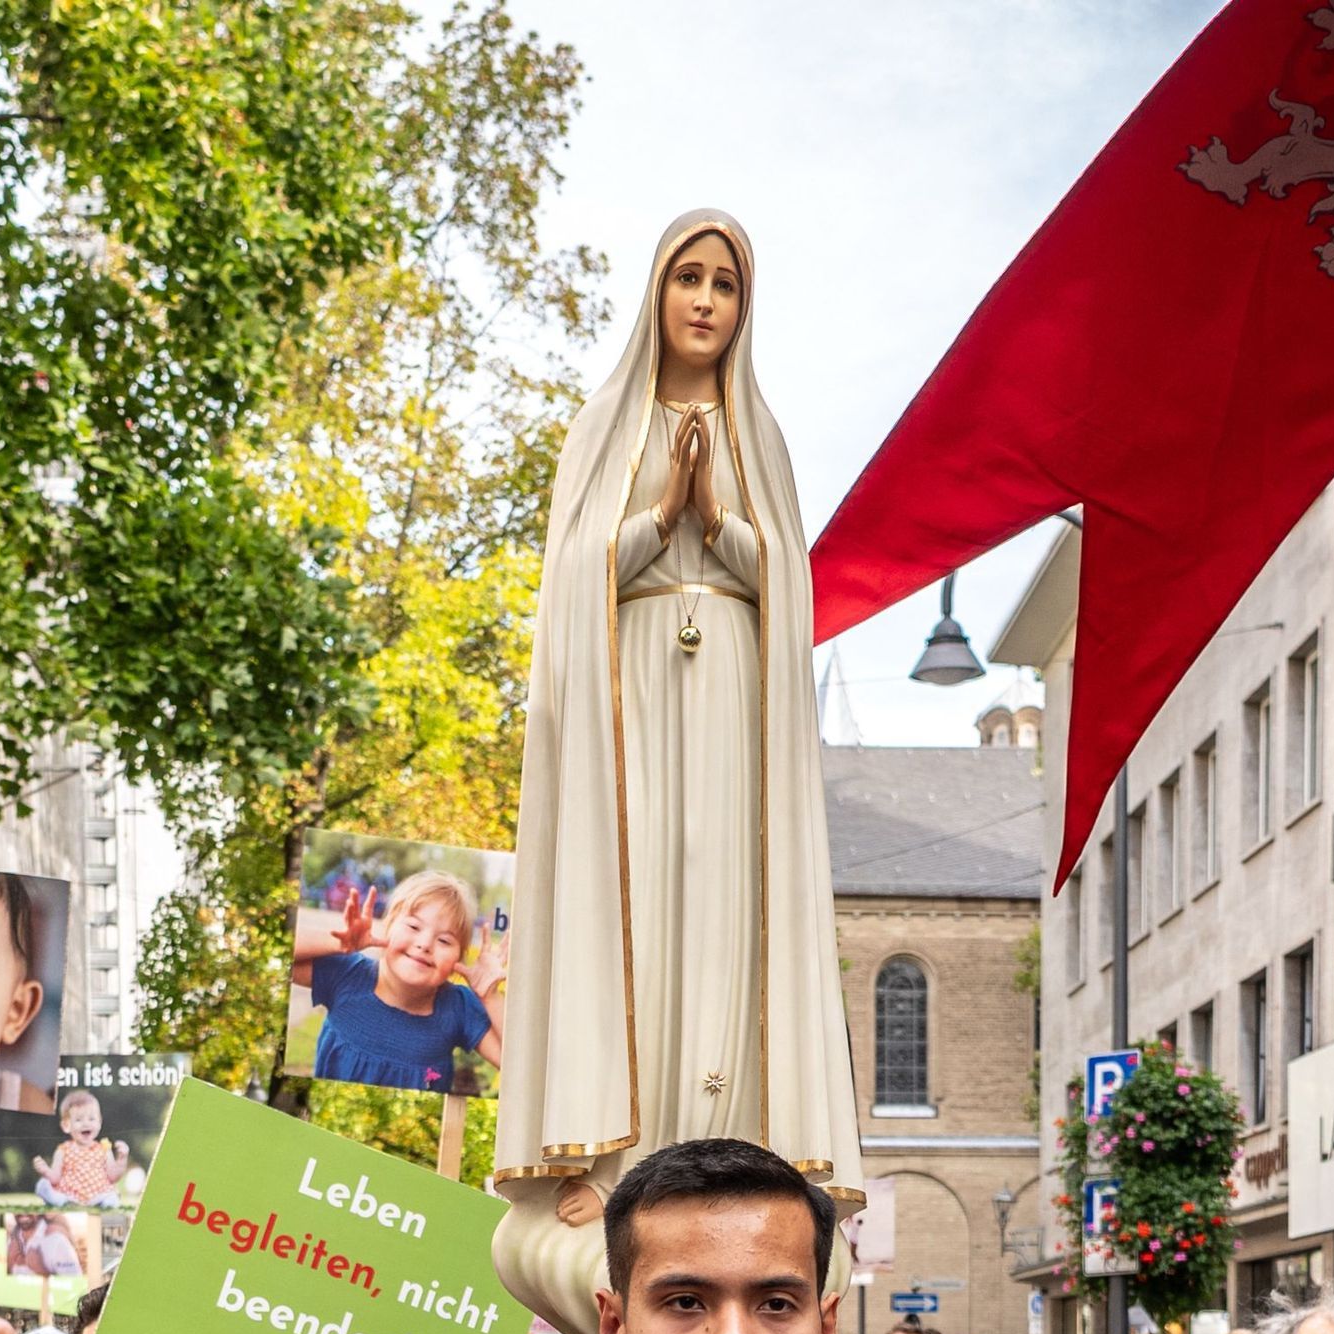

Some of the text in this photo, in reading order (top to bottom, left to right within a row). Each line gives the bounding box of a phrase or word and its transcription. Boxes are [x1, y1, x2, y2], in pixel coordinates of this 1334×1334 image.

[57, 1066, 78, 1087] en
[85, 1062, 113, 1087] ist
[1094, 1062, 1124, 1114] P
[297, 1157, 427, 1239] Leben
[177, 1181, 500, 1334] begleiten, nicht
